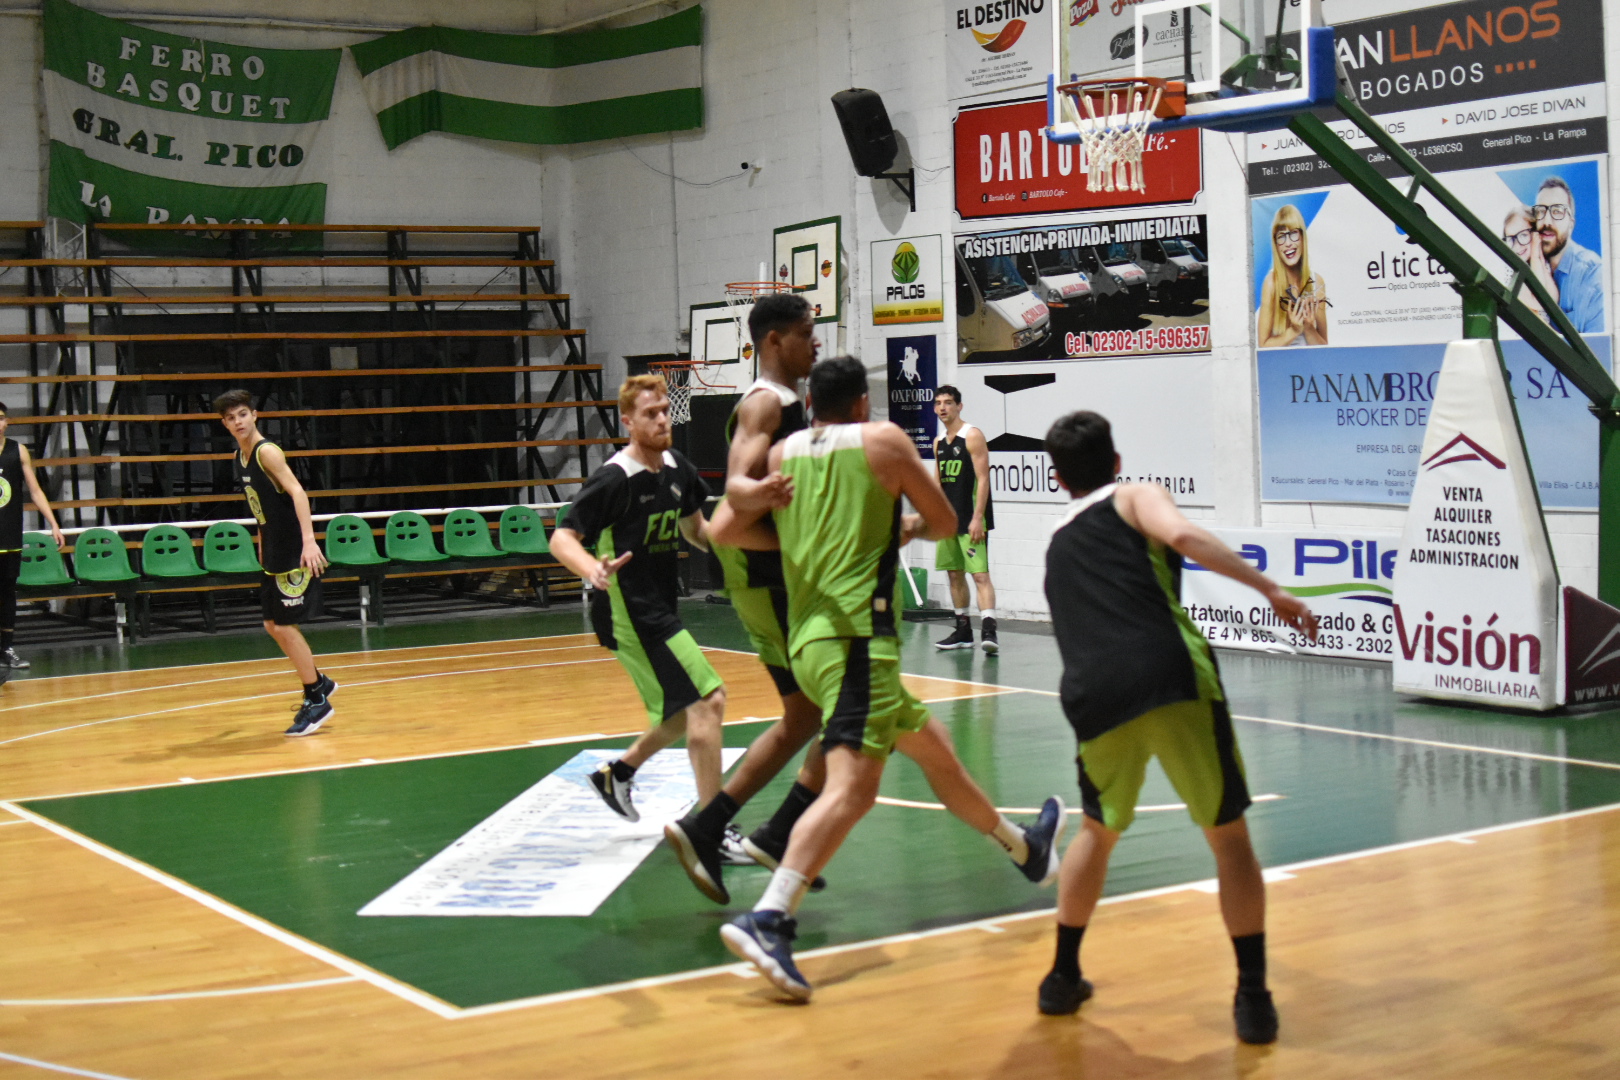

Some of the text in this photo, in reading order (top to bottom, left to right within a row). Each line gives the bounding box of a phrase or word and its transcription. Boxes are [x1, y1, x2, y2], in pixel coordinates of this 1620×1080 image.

[957, 0, 1044, 29] EL DESTINO
[119, 36, 265, 80] FERRO
[87, 61, 290, 119] BASQUET
[1359, 62, 1485, 101] BOGADOS
[1456, 96, 1586, 125] DAVID JOSE DIVAN
[72, 107, 304, 169] GRAL. PICO
[1274, 137, 1304, 150] JUAN
[1283, 161, 1314, 175] (02302)
[1367, 153, 1386, 163] Calle
[1423, 142, 1463, 156] L6360CSQ
[1482, 136, 1513, 148] General
[1514, 134, 1532, 145] Pico
[1543, 131, 1554, 141] La
[1558, 128, 1587, 140] Pampa
[980, 128, 1092, 183] BARTOL
[79, 180, 112, 217] LA
[1029, 189, 1053, 199] BARTOLO
[1367, 251, 1385, 279] el
[1391, 251, 1420, 278] tic
[887, 284, 925, 301] PALOS
[1065, 333, 1091, 355] Cel.
[891, 388, 934, 402] OXFORD
[1526, 367, 1571, 399] SA
[1337, 408, 1427, 427] BROKER DE
[1356, 444, 1390, 454] EMPRESA
[1391, 444, 1406, 454] DEL
[1443, 486, 1483, 502] VENTA
[1434, 507, 1492, 524] ALQUILER
[1426, 528, 1501, 547] TASACIONES
[1294, 538, 1398, 580] Pile
[1409, 548, 1519, 570] ADMINISTRACION
[1182, 604, 1244, 626] tatorio
[1362, 614, 1376, 633] &
[1221, 627, 1229, 641] 4
[1252, 629, 1277, 643] 865
[1393, 604, 1541, 675] Visión
[1435, 674, 1541, 700] INMOBILIARIA
